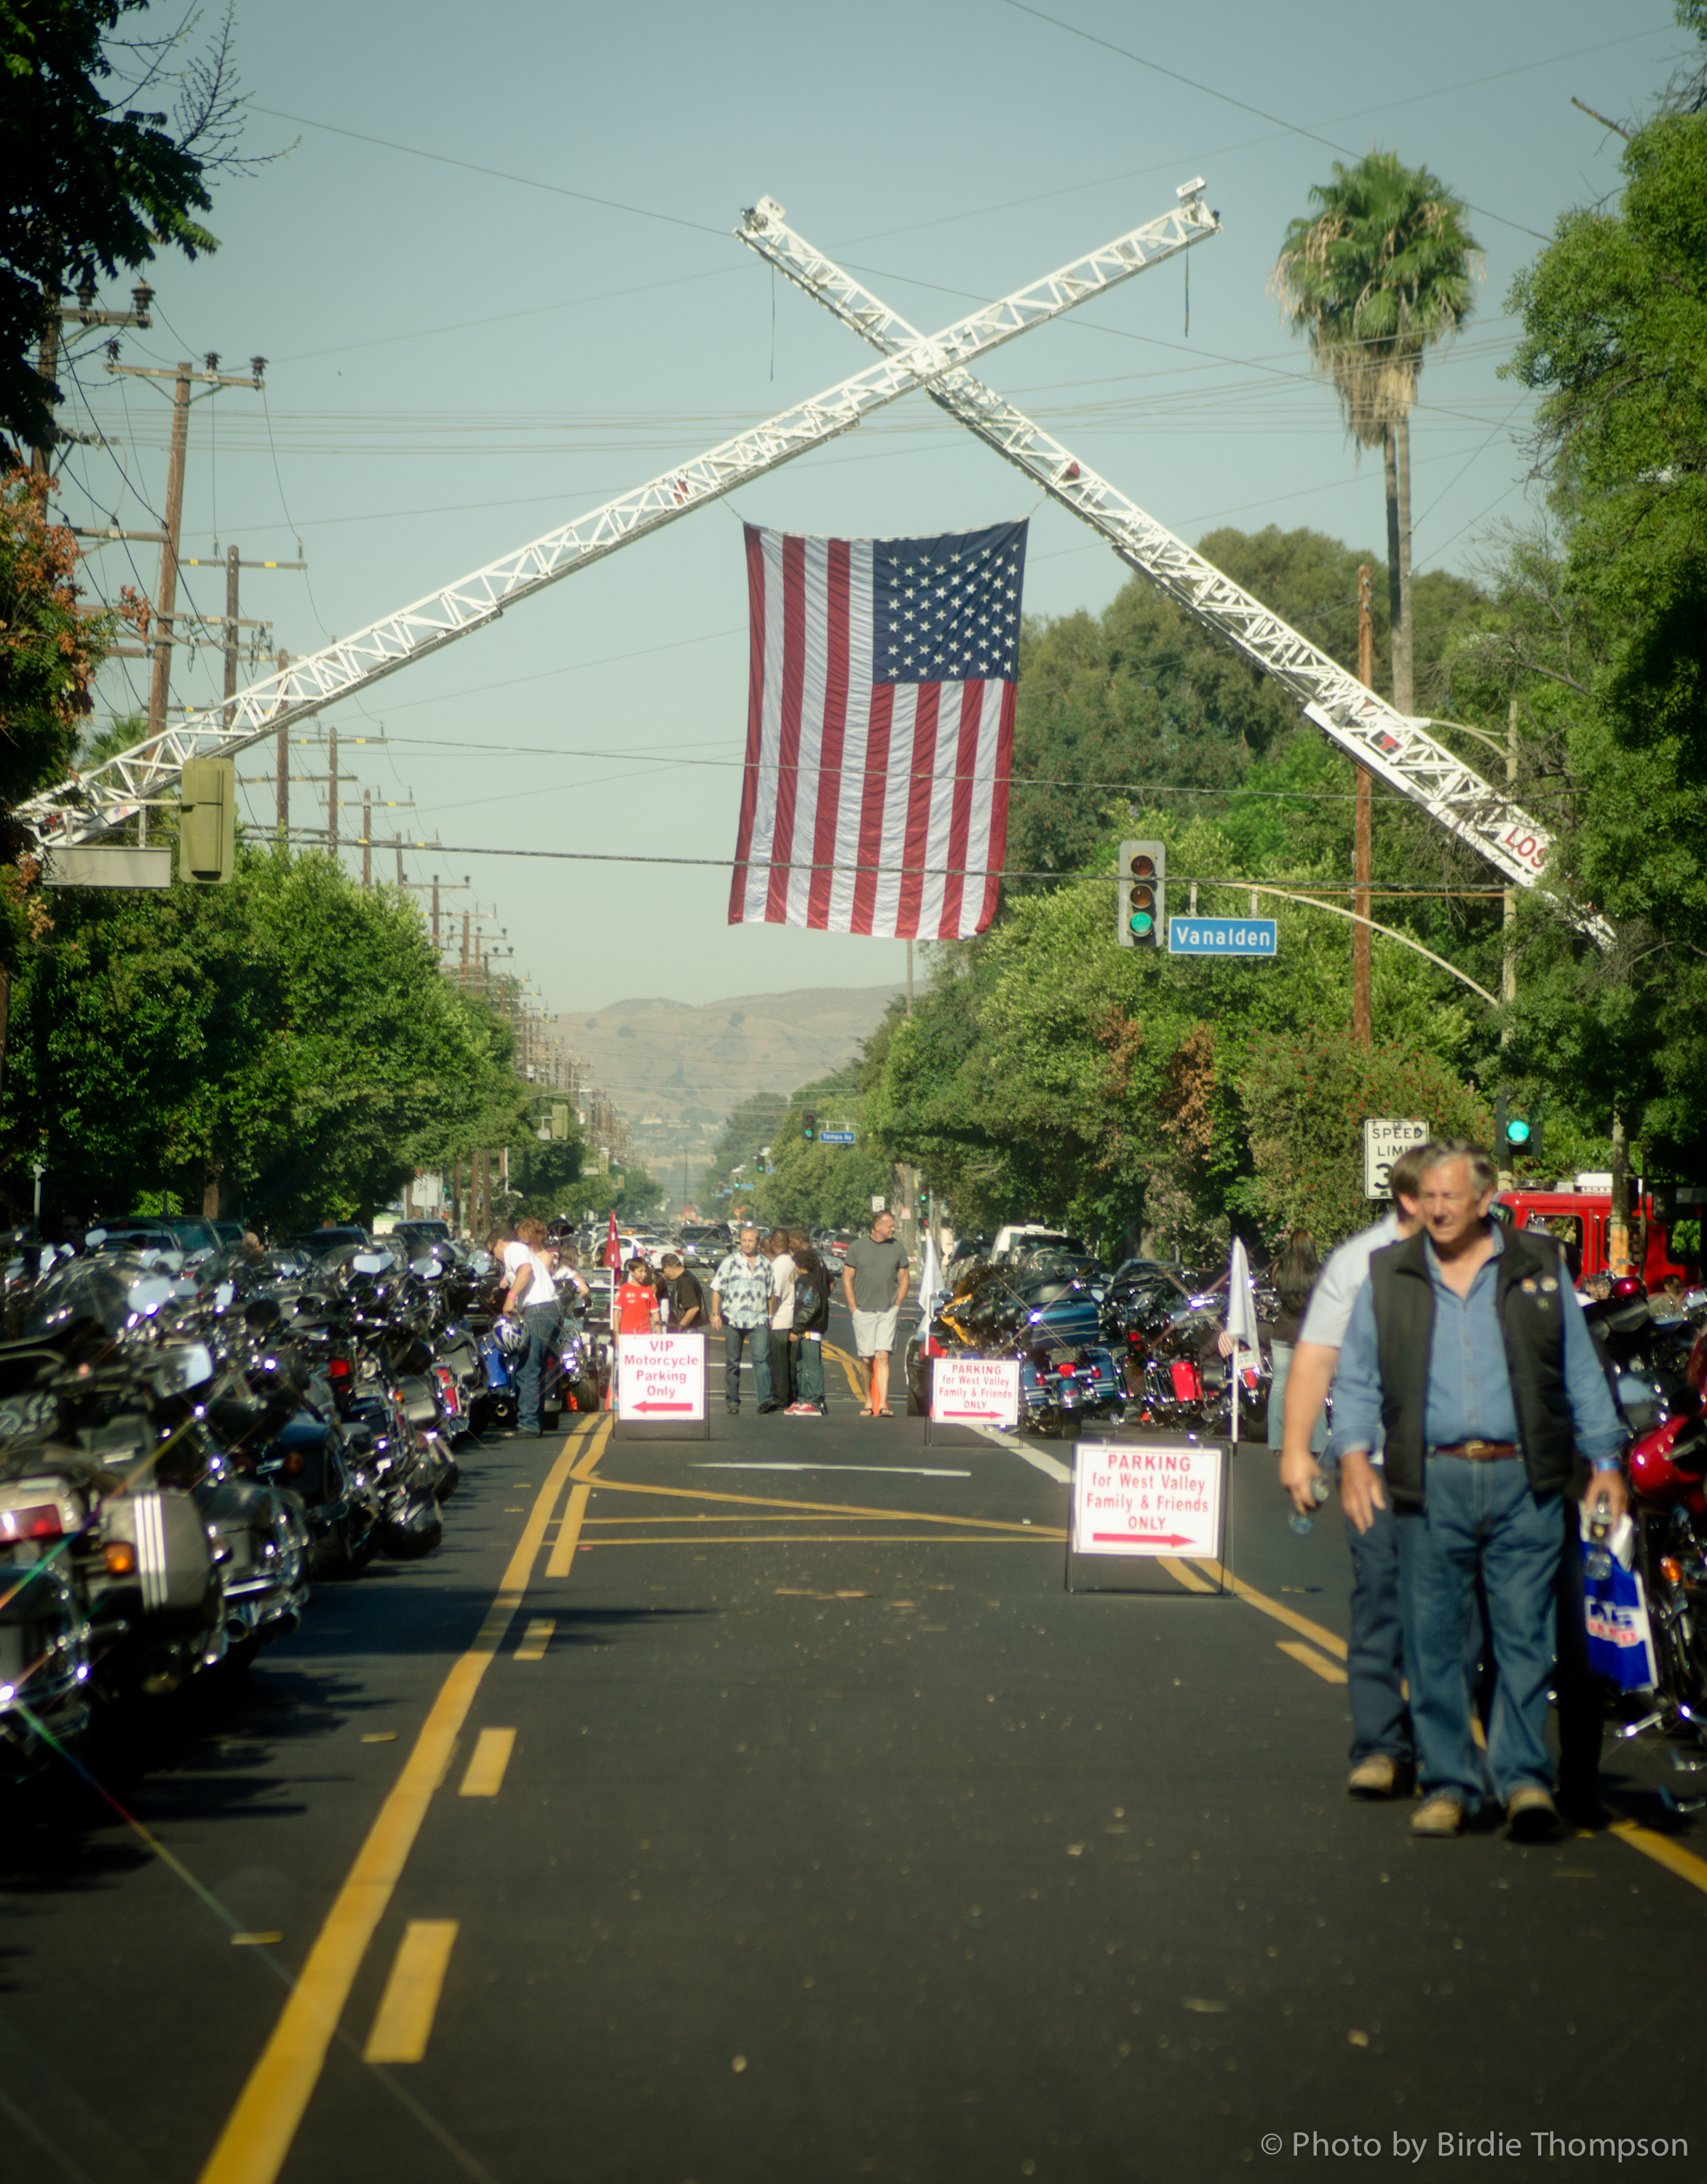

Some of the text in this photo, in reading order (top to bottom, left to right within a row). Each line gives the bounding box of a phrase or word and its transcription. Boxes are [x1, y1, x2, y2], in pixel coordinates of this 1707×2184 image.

[1505, 826, 1547, 869] LOS
[1176, 927, 1270, 946] Vanalden
[823, 1133, 843, 1141] Tampa
[1372, 1128, 1422, 1139] SPEED
[650, 1340, 674, 1352] VIP
[625, 1355, 698, 1368] Motorcycle
[952, 1364, 1002, 1374] PARKING
[636, 1370, 686, 1384] Parking
[943, 1374, 1010, 1388] for West Valley
[646, 1385, 676, 1398] Only
[939, 1387, 1012, 1399] Family & Friends
[964, 1401, 986, 1409] ONLY
[1108, 1455, 1191, 1472] PARKING
[1093, 1472, 1205, 1495] for West Valley
[1087, 1492, 1209, 1514] Family & Friends
[1128, 1516, 1166, 1531] ONLY
